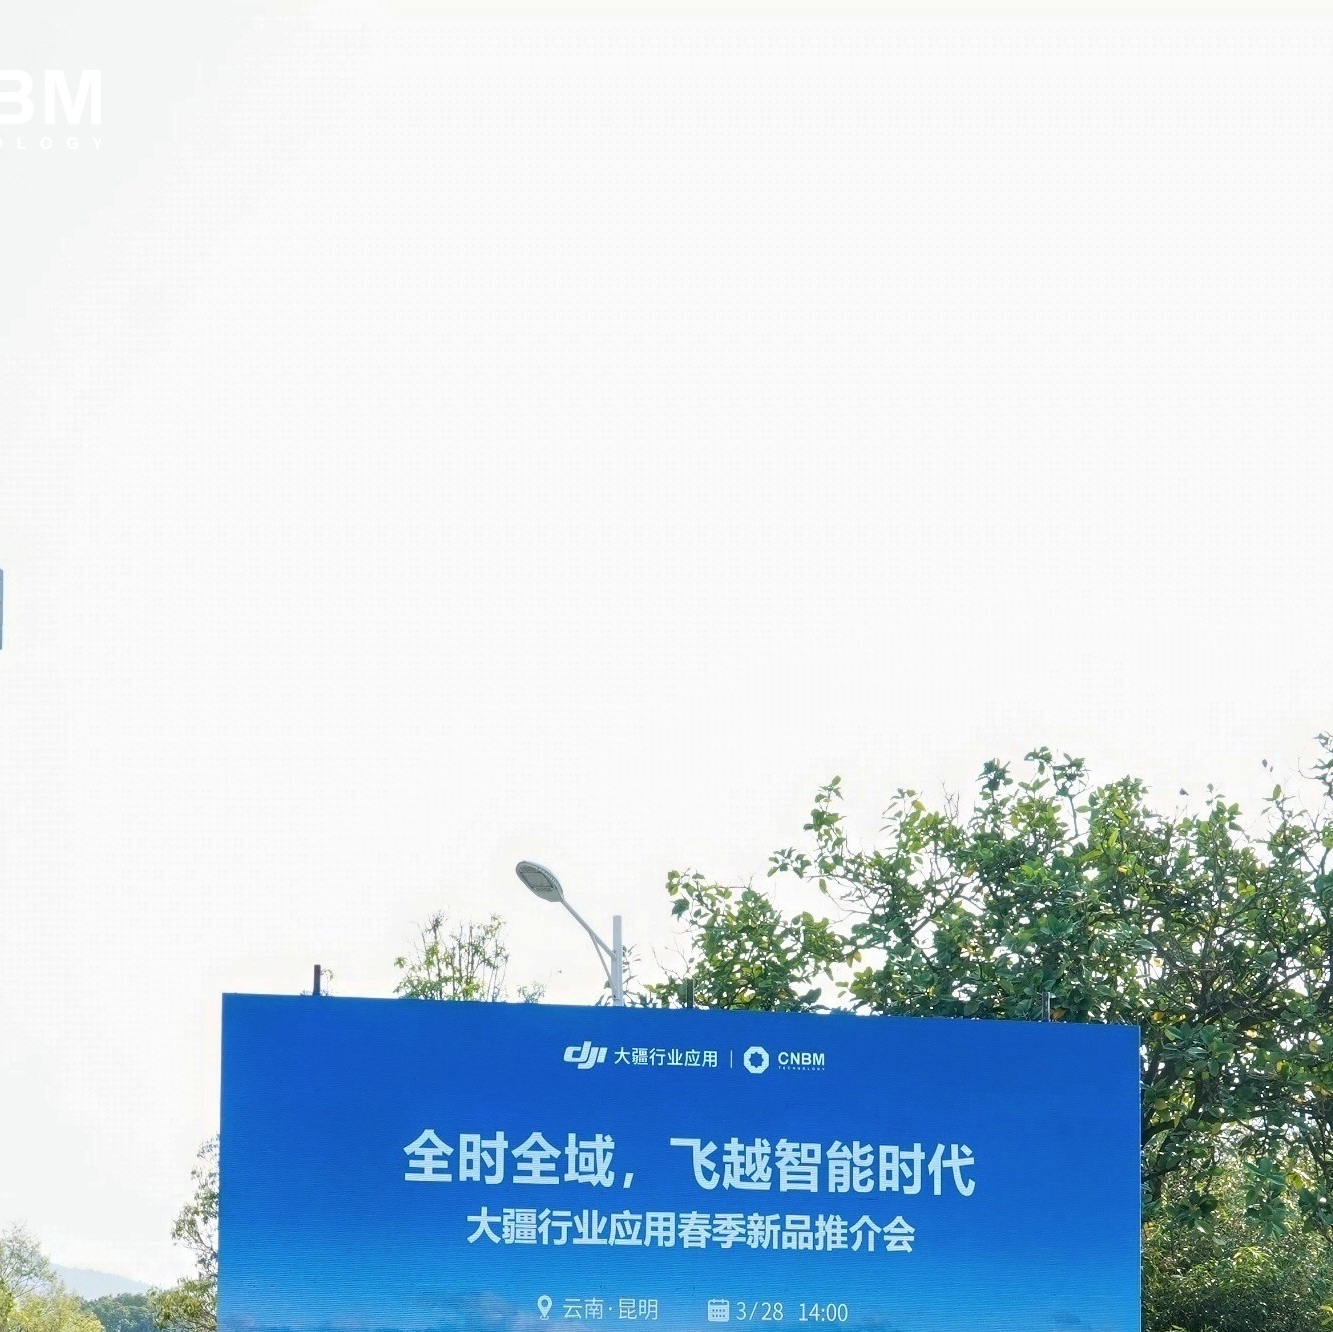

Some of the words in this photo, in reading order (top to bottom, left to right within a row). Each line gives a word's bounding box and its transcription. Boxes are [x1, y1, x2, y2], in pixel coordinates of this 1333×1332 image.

[614, 1047, 718, 1067] 大疆行业应用
[778, 1052, 825, 1065] CNBM
[466, 1206, 916, 1253] 大疆行业应用春季新品推介会
[736, 1301, 784, 1322] 3/28
[799, 1302, 849, 1322] 14:00
